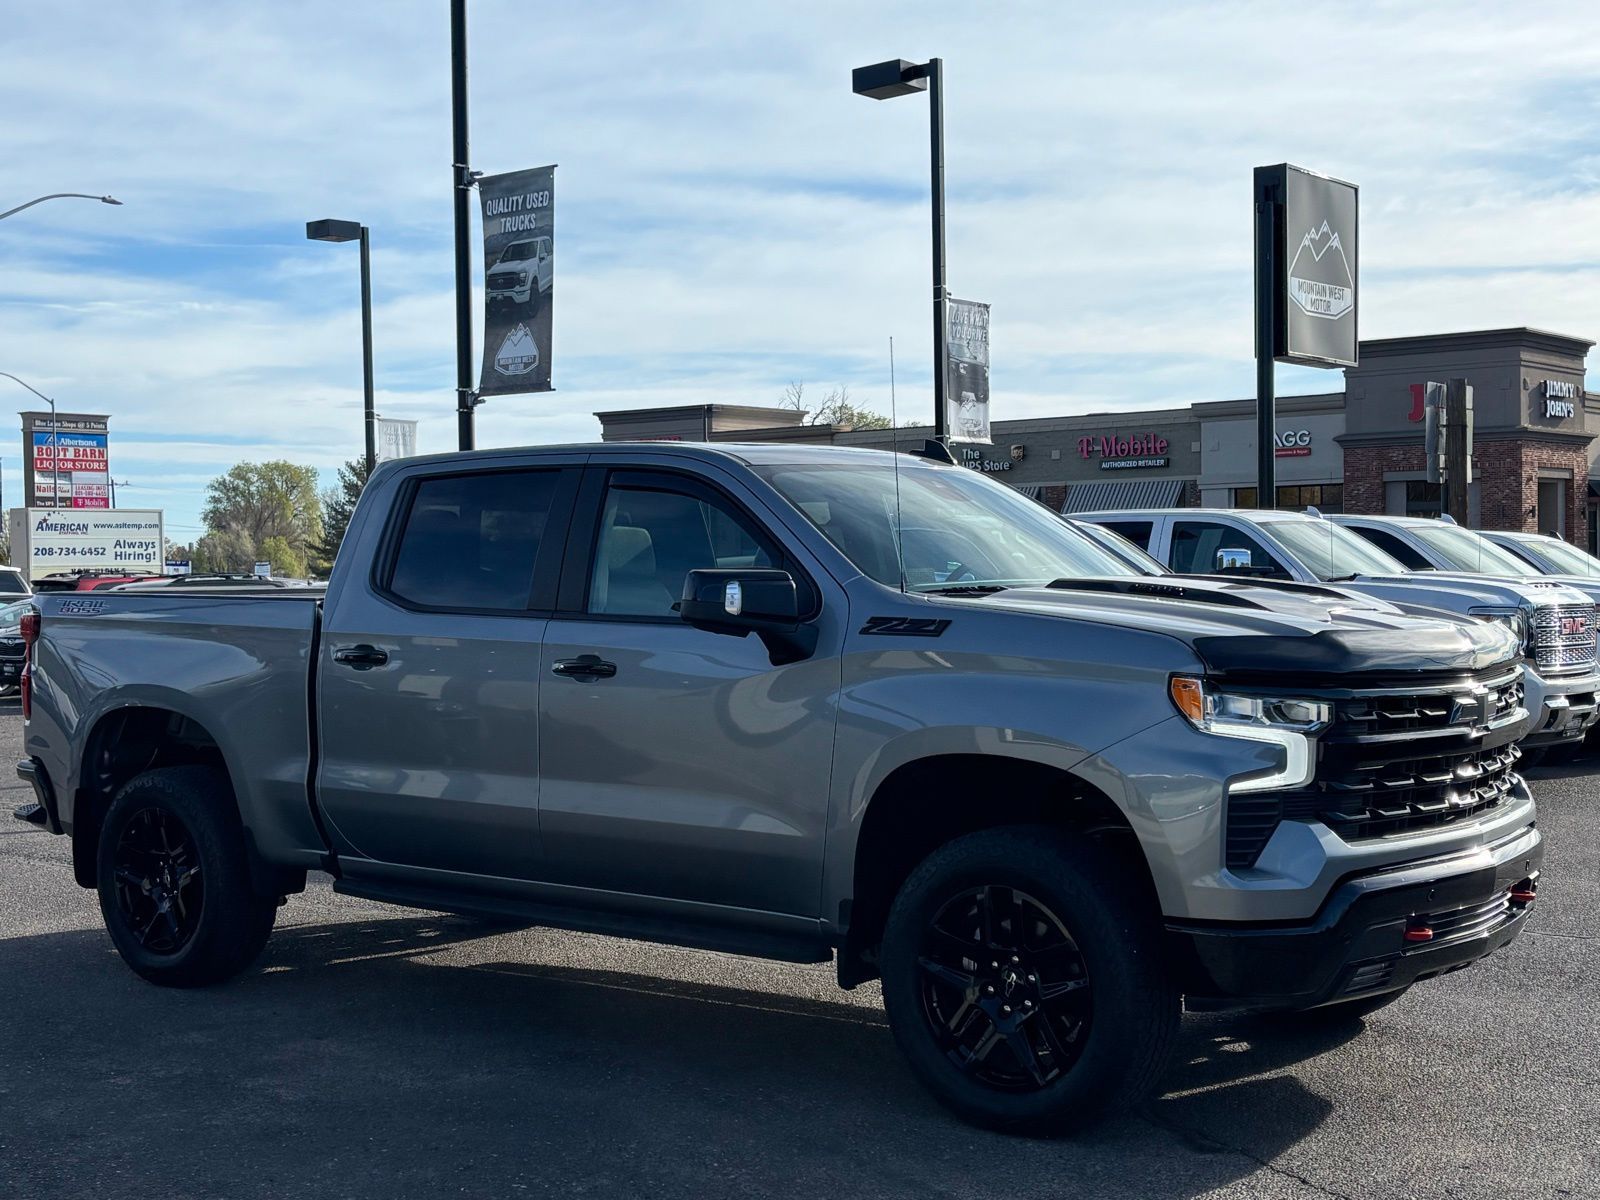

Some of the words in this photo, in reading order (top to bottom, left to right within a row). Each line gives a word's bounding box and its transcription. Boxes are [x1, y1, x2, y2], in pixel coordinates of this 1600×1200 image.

[486, 194, 524, 217] QUALITY
[526, 190, 549, 210] USED
[500, 213, 536, 233] TRUCKS
[1297, 279, 1327, 298] MOUNTAIN
[1328, 285, 1345, 301] WEST
[1310, 297, 1331, 312] MOTOR
[1546, 379, 1574, 398] JIMMY
[1546, 399, 1574, 418] JOHN'S
[59, 438, 97, 447] Albertsons
[73, 448, 105, 459] BARN
[962, 448, 980, 459] The
[75, 461, 106, 470] STORE
[984, 460, 1009, 471] Store
[1101, 460, 1137, 469] AUTHORIZED
[1138, 459, 1165, 467] RETAILER
[36, 520, 89, 532] AMERICAN
[34, 547, 107, 556] 208-734-6452
[113, 540, 156, 551] Always
[114, 551, 156, 563] Hiring!
[1561, 617, 1587, 635] GMC
